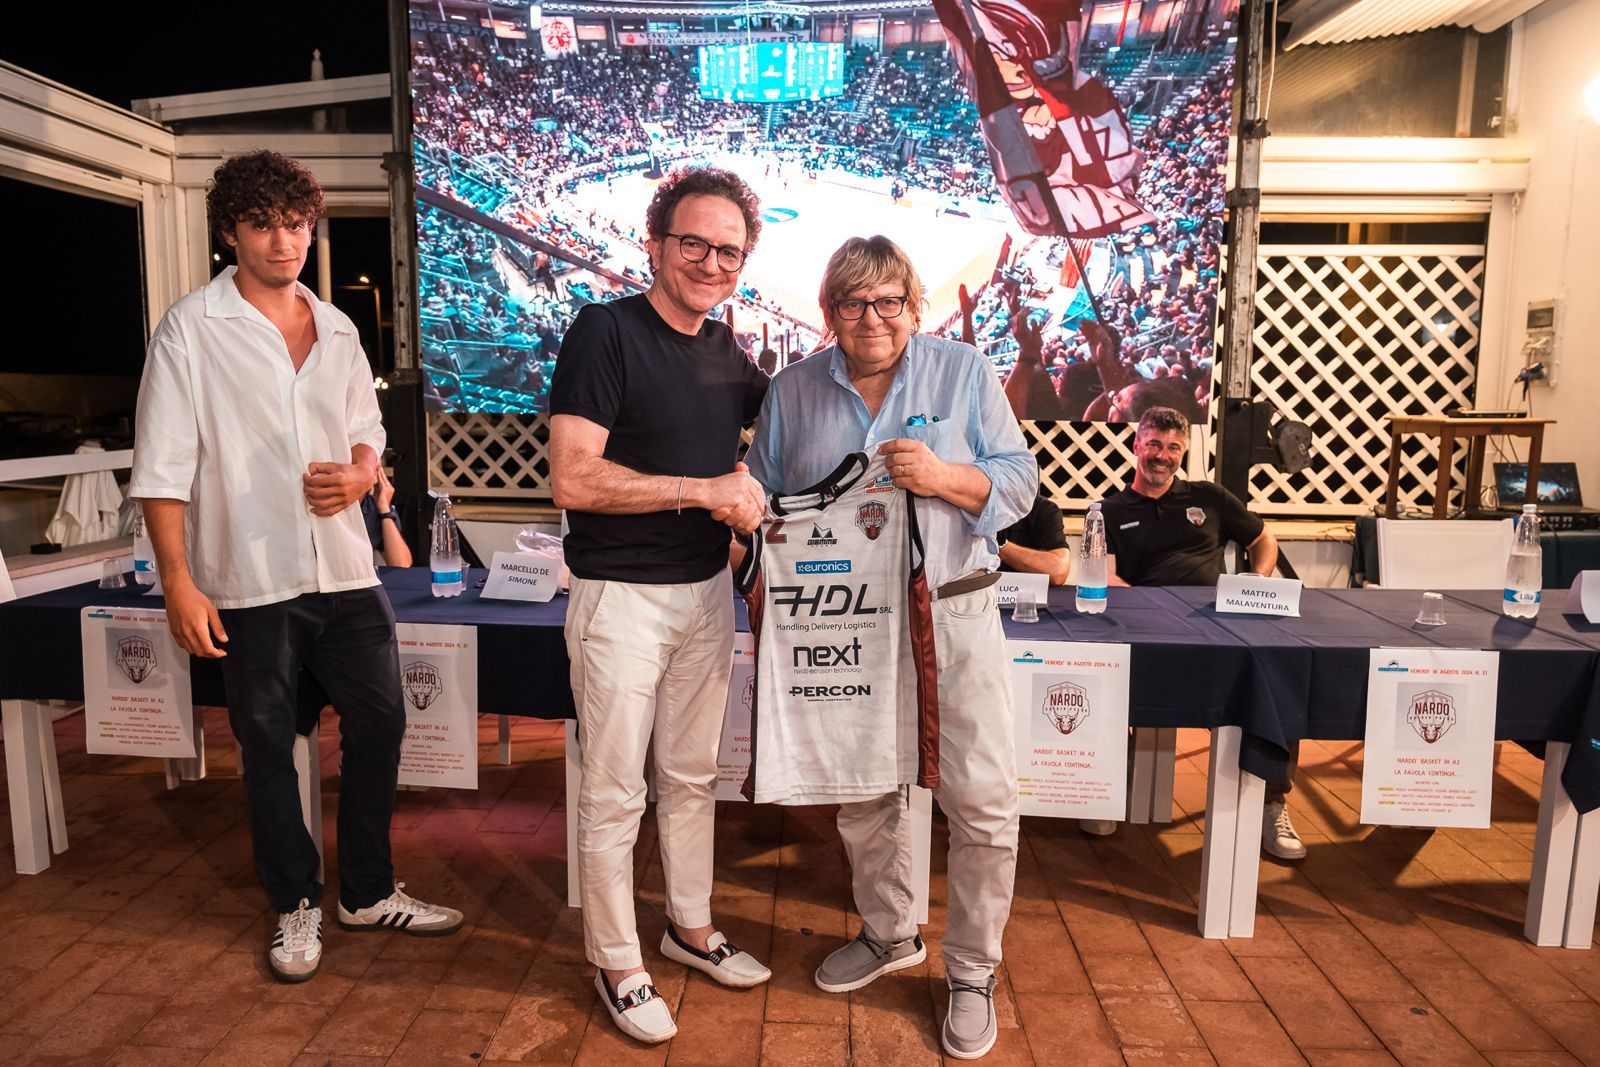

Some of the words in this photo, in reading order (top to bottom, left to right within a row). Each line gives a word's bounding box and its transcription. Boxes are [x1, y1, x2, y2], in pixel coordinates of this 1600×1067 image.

[501, 563, 539, 575] MARCELLO
[540, 568, 550, 576] DE
[805, 562, 849, 572] euronics
[507, 575, 538, 586] SIMONE
[1241, 589, 1277, 599] MATTEO
[769, 584, 877, 617] HDL
[1226, 598, 1290, 611] MALAVENTURA
[776, 622, 809, 632] Handling
[811, 622, 842, 631] Delivery
[844, 621, 877, 631] Logistics
[793, 637, 862, 667] next
[789, 685, 871, 697] PERCON
[1056, 749, 1077, 757] BASKET
